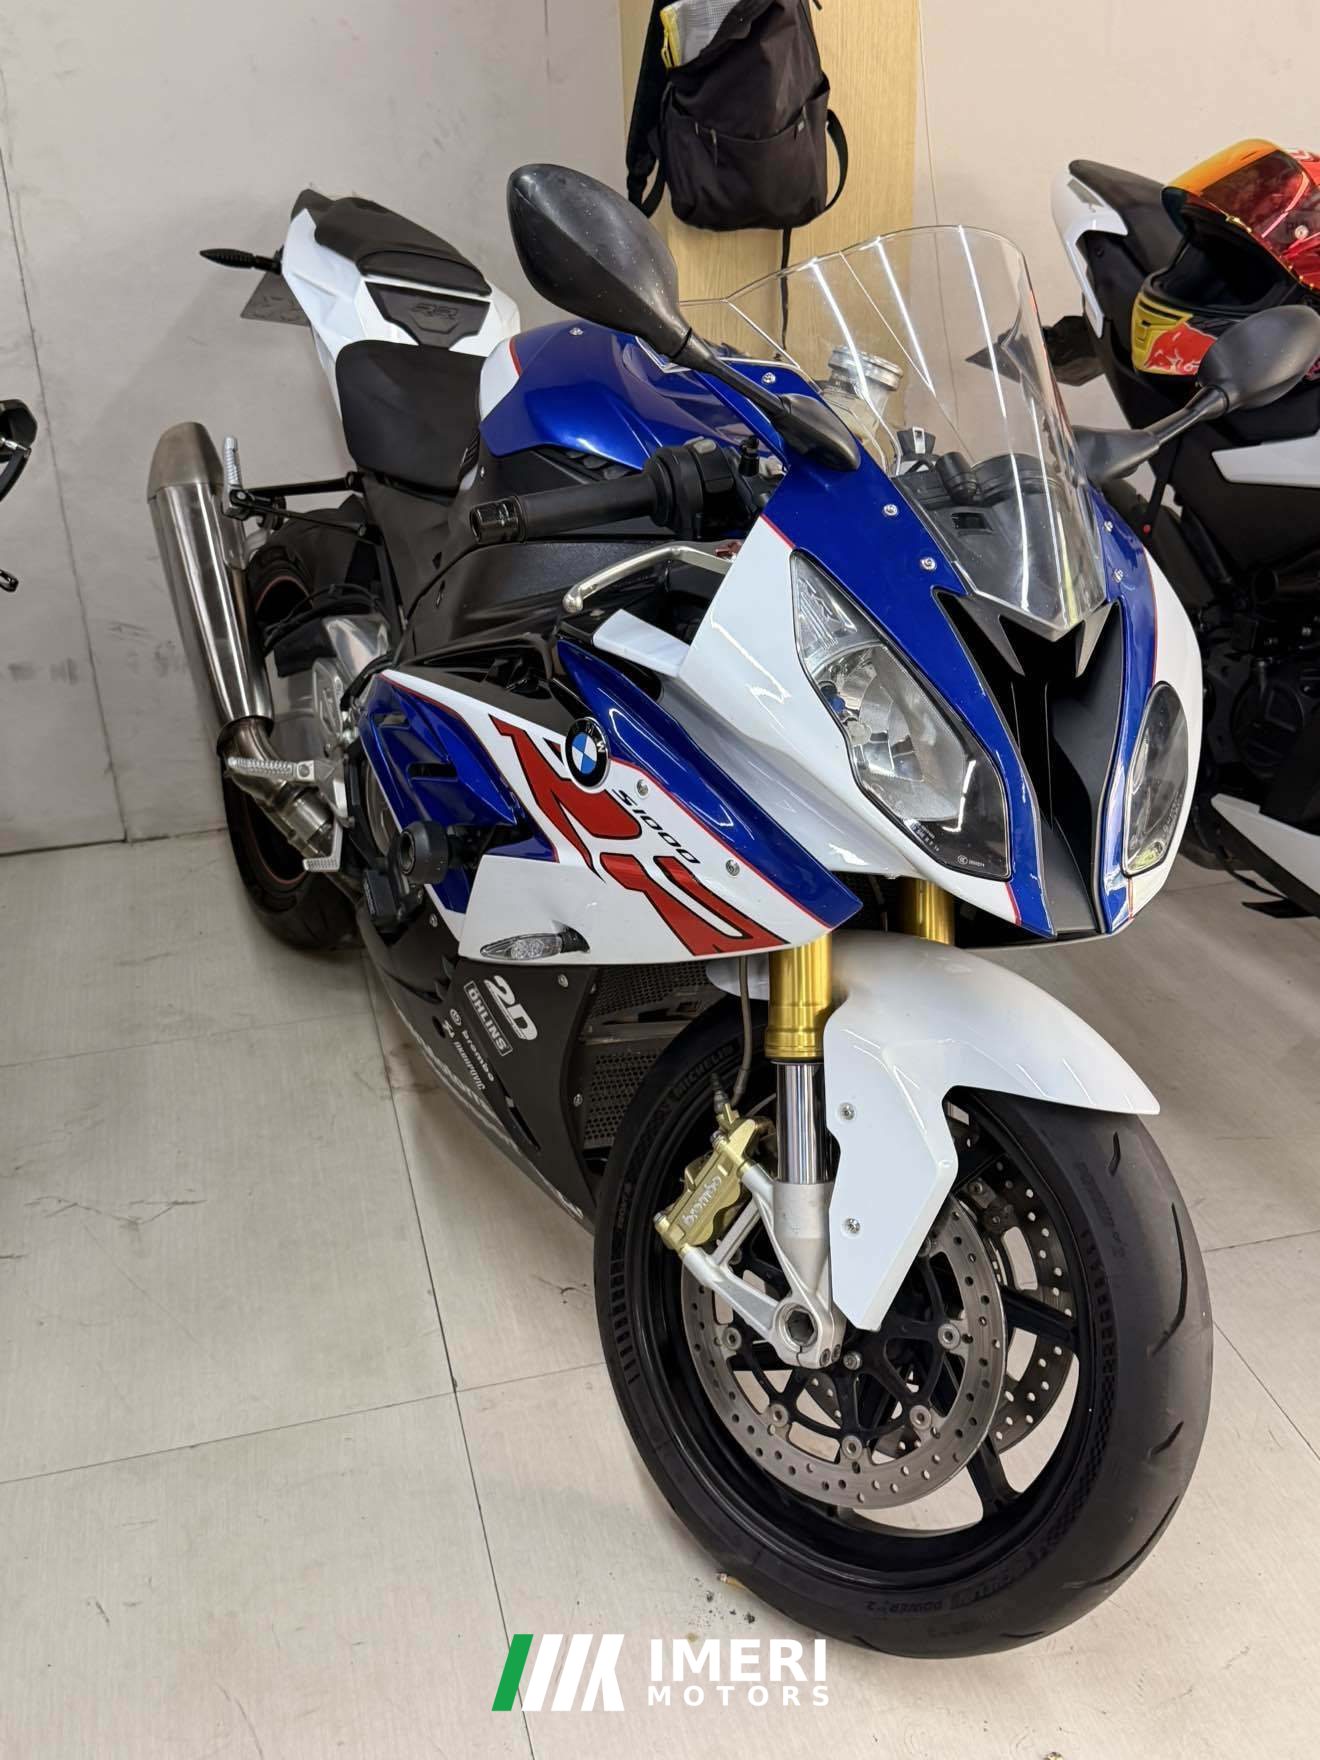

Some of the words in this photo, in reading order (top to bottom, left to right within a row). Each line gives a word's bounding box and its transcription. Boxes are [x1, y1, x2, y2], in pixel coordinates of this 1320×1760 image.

[612, 788, 701, 865] S1000
[484, 974, 538, 1041] 2D
[461, 1029, 495, 1082] brembo
[673, 1043, 737, 1099] MICHELIN
[680, 1174, 723, 1228] brembo
